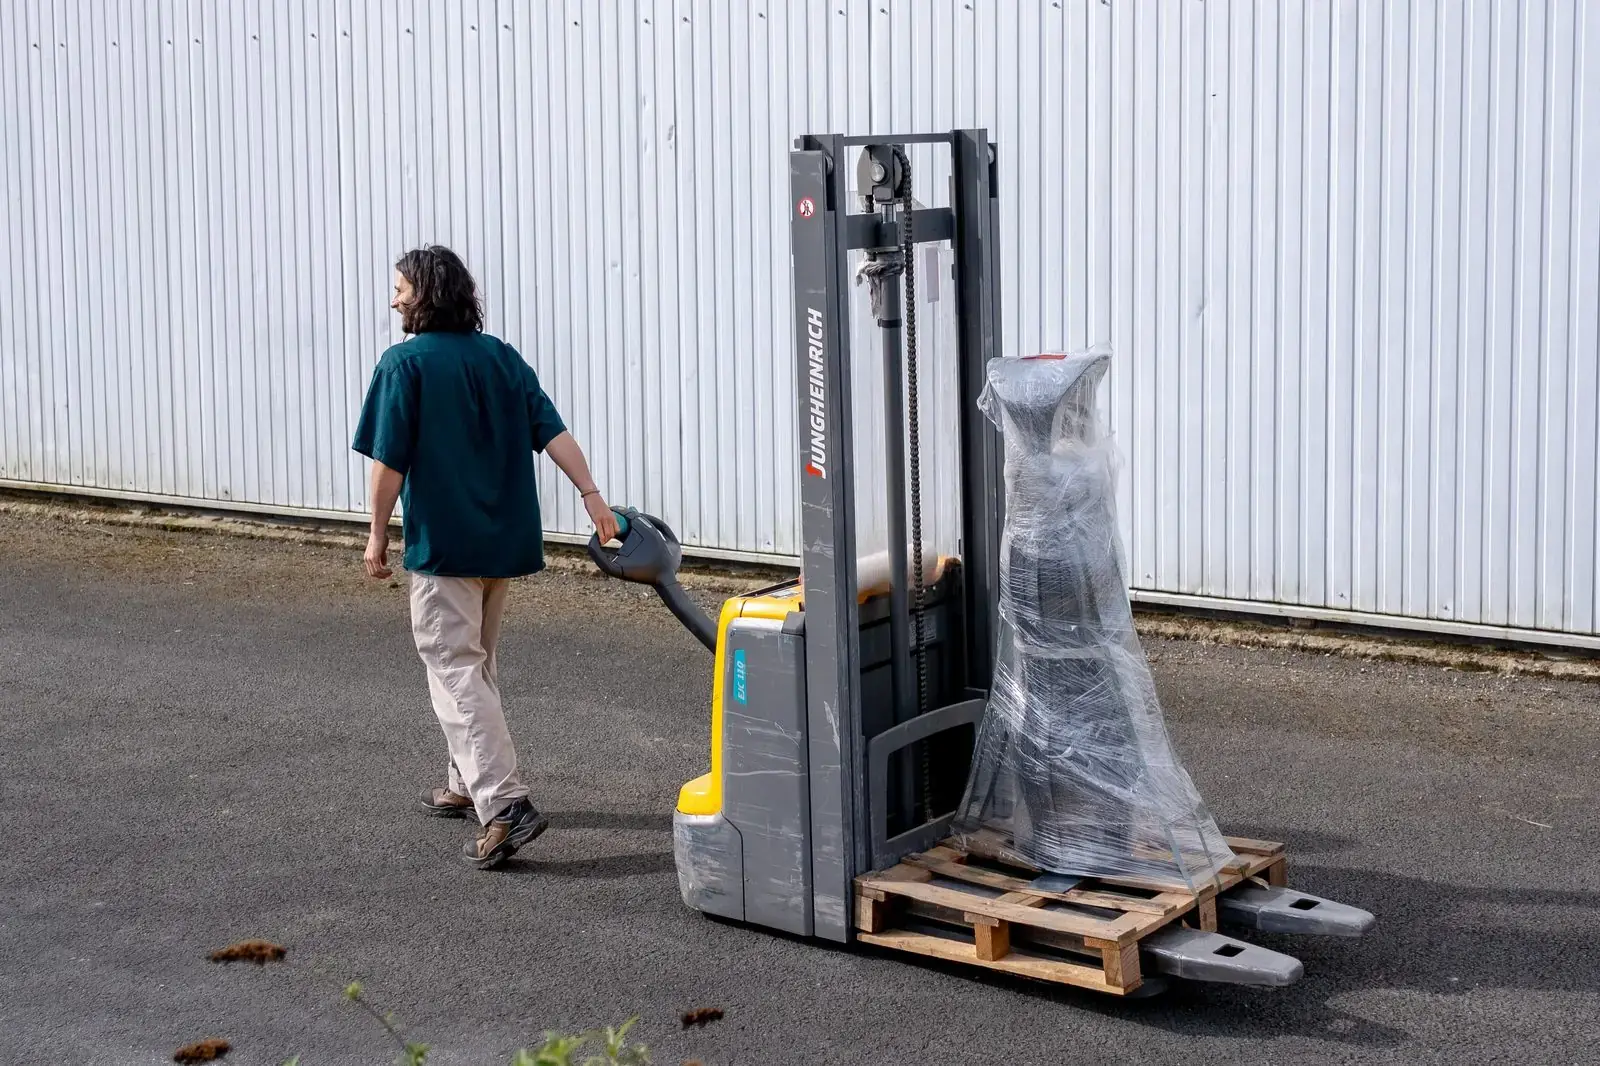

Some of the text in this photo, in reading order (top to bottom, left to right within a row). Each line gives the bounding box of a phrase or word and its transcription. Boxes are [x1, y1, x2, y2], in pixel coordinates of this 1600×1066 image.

[806, 307, 827, 479] JUNGHEINRICH
[736, 660, 745, 700] EJC 110
